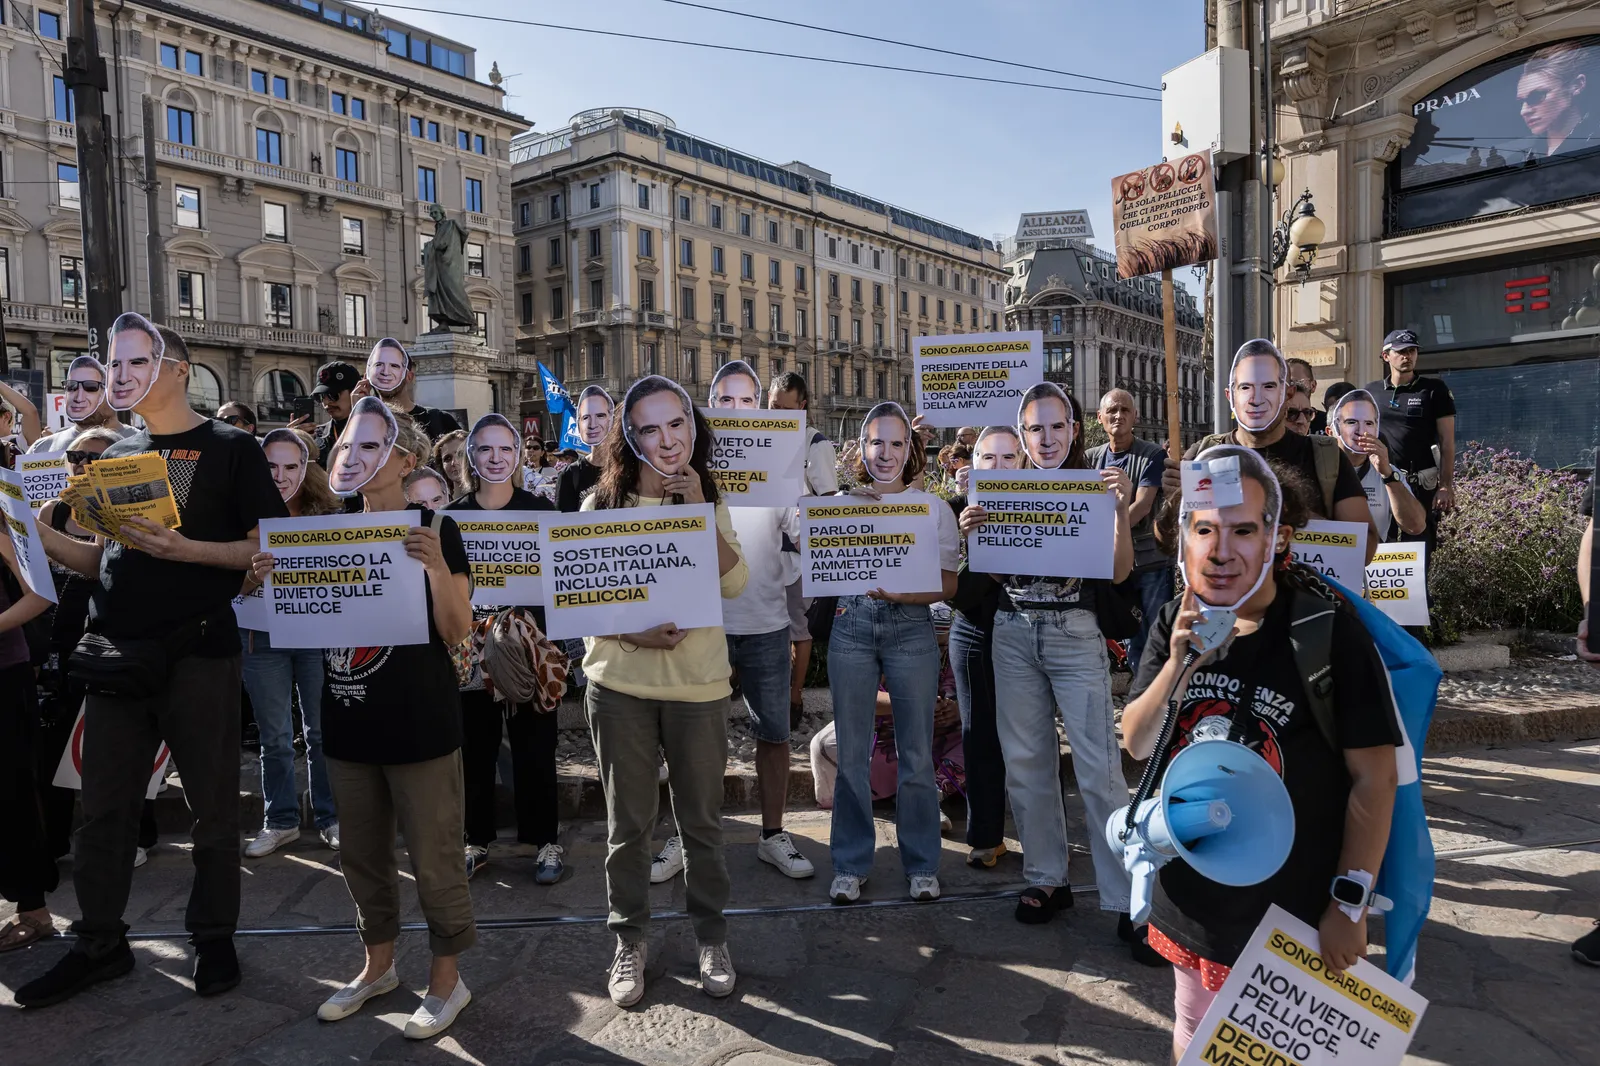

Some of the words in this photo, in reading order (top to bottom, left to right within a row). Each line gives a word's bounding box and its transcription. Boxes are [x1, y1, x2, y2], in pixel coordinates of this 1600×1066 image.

[1414, 88, 1481, 116] PRADA
[1124, 201, 1134, 211] LA
[1136, 196, 1156, 207] SOLA
[1158, 184, 1202, 202] PELLICCIA
[1122, 210, 1138, 220] CHE
[1140, 208, 1148, 216] CI
[1150, 194, 1198, 213] APPARTIENE
[1023, 215, 1086, 228] ALLEANZA
[1120, 218, 1151, 230] QUELLA
[1153, 212, 1169, 222] DEL
[1171, 201, 1209, 216] PROPRIO
[1148, 218, 1180, 232] CORPO!
[1022, 226, 1086, 237] ASSICURAZIONI
[950, 345, 985, 353] CARLO
[987, 343, 1029, 352] CAPASA
[922, 361, 989, 372] PRESIDENTE
[992, 360, 1028, 369] DELLA
[922, 372, 970, 381] CAMERA
[973, 370, 1008, 380] DELLA
[922, 382, 957, 391] MODA
[968, 380, 1005, 389] GUIDO
[923, 389, 1024, 401] L'ORGANIZZAZION
[923, 401, 956, 409] DELLA
[958, 400, 987, 408] MFW
[525, 421, 539, 433] M
[713, 438, 754, 447] VIETO
[757, 438, 772, 447] LE
[161, 449, 170, 459] TO
[170, 449, 201, 460] ABOLISH
[24, 461, 52, 469] SONO
[711, 471, 746, 480] DERE
[749, 472, 766, 481] AL
[1052, 483, 1103, 491] CAPASA:
[809, 508, 840, 516] SONO
[843, 507, 880, 515] CARLO
[882, 506, 926, 514] CAPASA:
[978, 501, 1067, 512] PREFERISCO
[1071, 502, 1089, 512] LA
[987, 512, 1064, 524] EUTRALITÀ
[1068, 515, 1086, 524] AL
[551, 527, 591, 538] SONO
[594, 523, 641, 534] CARLO
[644, 520, 702, 531] CAPASA:
[810, 525, 858, 536] PARLO
[861, 524, 874, 534] DI
[978, 525, 1031, 535] DIVIETO
[1035, 526, 1079, 537] SULLE
[270, 533, 300, 544] SONO
[302, 531, 341, 542] CARLO
[344, 528, 406, 541] CAPASA:
[810, 533, 915, 548] SOSTENIBILITÀ,
[1294, 533, 1352, 544] CAPASA:
[502, 541, 540, 550] VUOL
[978, 537, 1042, 548] PELLICCE
[467, 553, 522, 562] ELLICCE
[526, 553, 540, 562] IO
[553, 544, 652, 562] SOSTENGO
[657, 542, 678, 554] LA
[811, 550, 833, 559] MA
[836, 548, 870, 558] ALLA
[874, 546, 909, 556] MFW
[273, 554, 366, 569] PREFERISCO
[370, 552, 392, 565] LA
[812, 559, 883, 570] AMMETTO
[886, 558, 901, 567] LE
[1304, 553, 1324, 564] LA
[487, 565, 540, 574] LASCIO
[554, 561, 610, 577] MODA
[613, 556, 696, 572] ITALIANA,
[273, 567, 364, 584] NEUTRALITÀ
[368, 569, 390, 580] AL
[812, 571, 877, 582] PELLICCE
[1366, 568, 1413, 578] VUOLE
[555, 574, 632, 591] INCLUSA
[635, 572, 657, 585] LA
[1391, 579, 1405, 588] IO
[273, 587, 328, 599] DIVIETO
[332, 584, 382, 598] SULLE
[556, 588, 645, 606] PELLICCIA
[275, 602, 342, 614] PELLICCE
[354, 672, 369, 680] ALLA
[368, 655, 388, 675] FASHION
[1185, 688, 1215, 700] ICCIA
[1217, 688, 1225, 699] È
[1271, 933, 1323, 972] SONO
[1325, 967, 1371, 1001] CARLO
[1251, 963, 1307, 1007] NON
[1309, 996, 1360, 1038] VIETO
[1360, 1023, 1381, 1050] LE
[1239, 983, 1341, 1058] PELLICCE,
[1228, 1003, 1311, 1061] LASCIO
